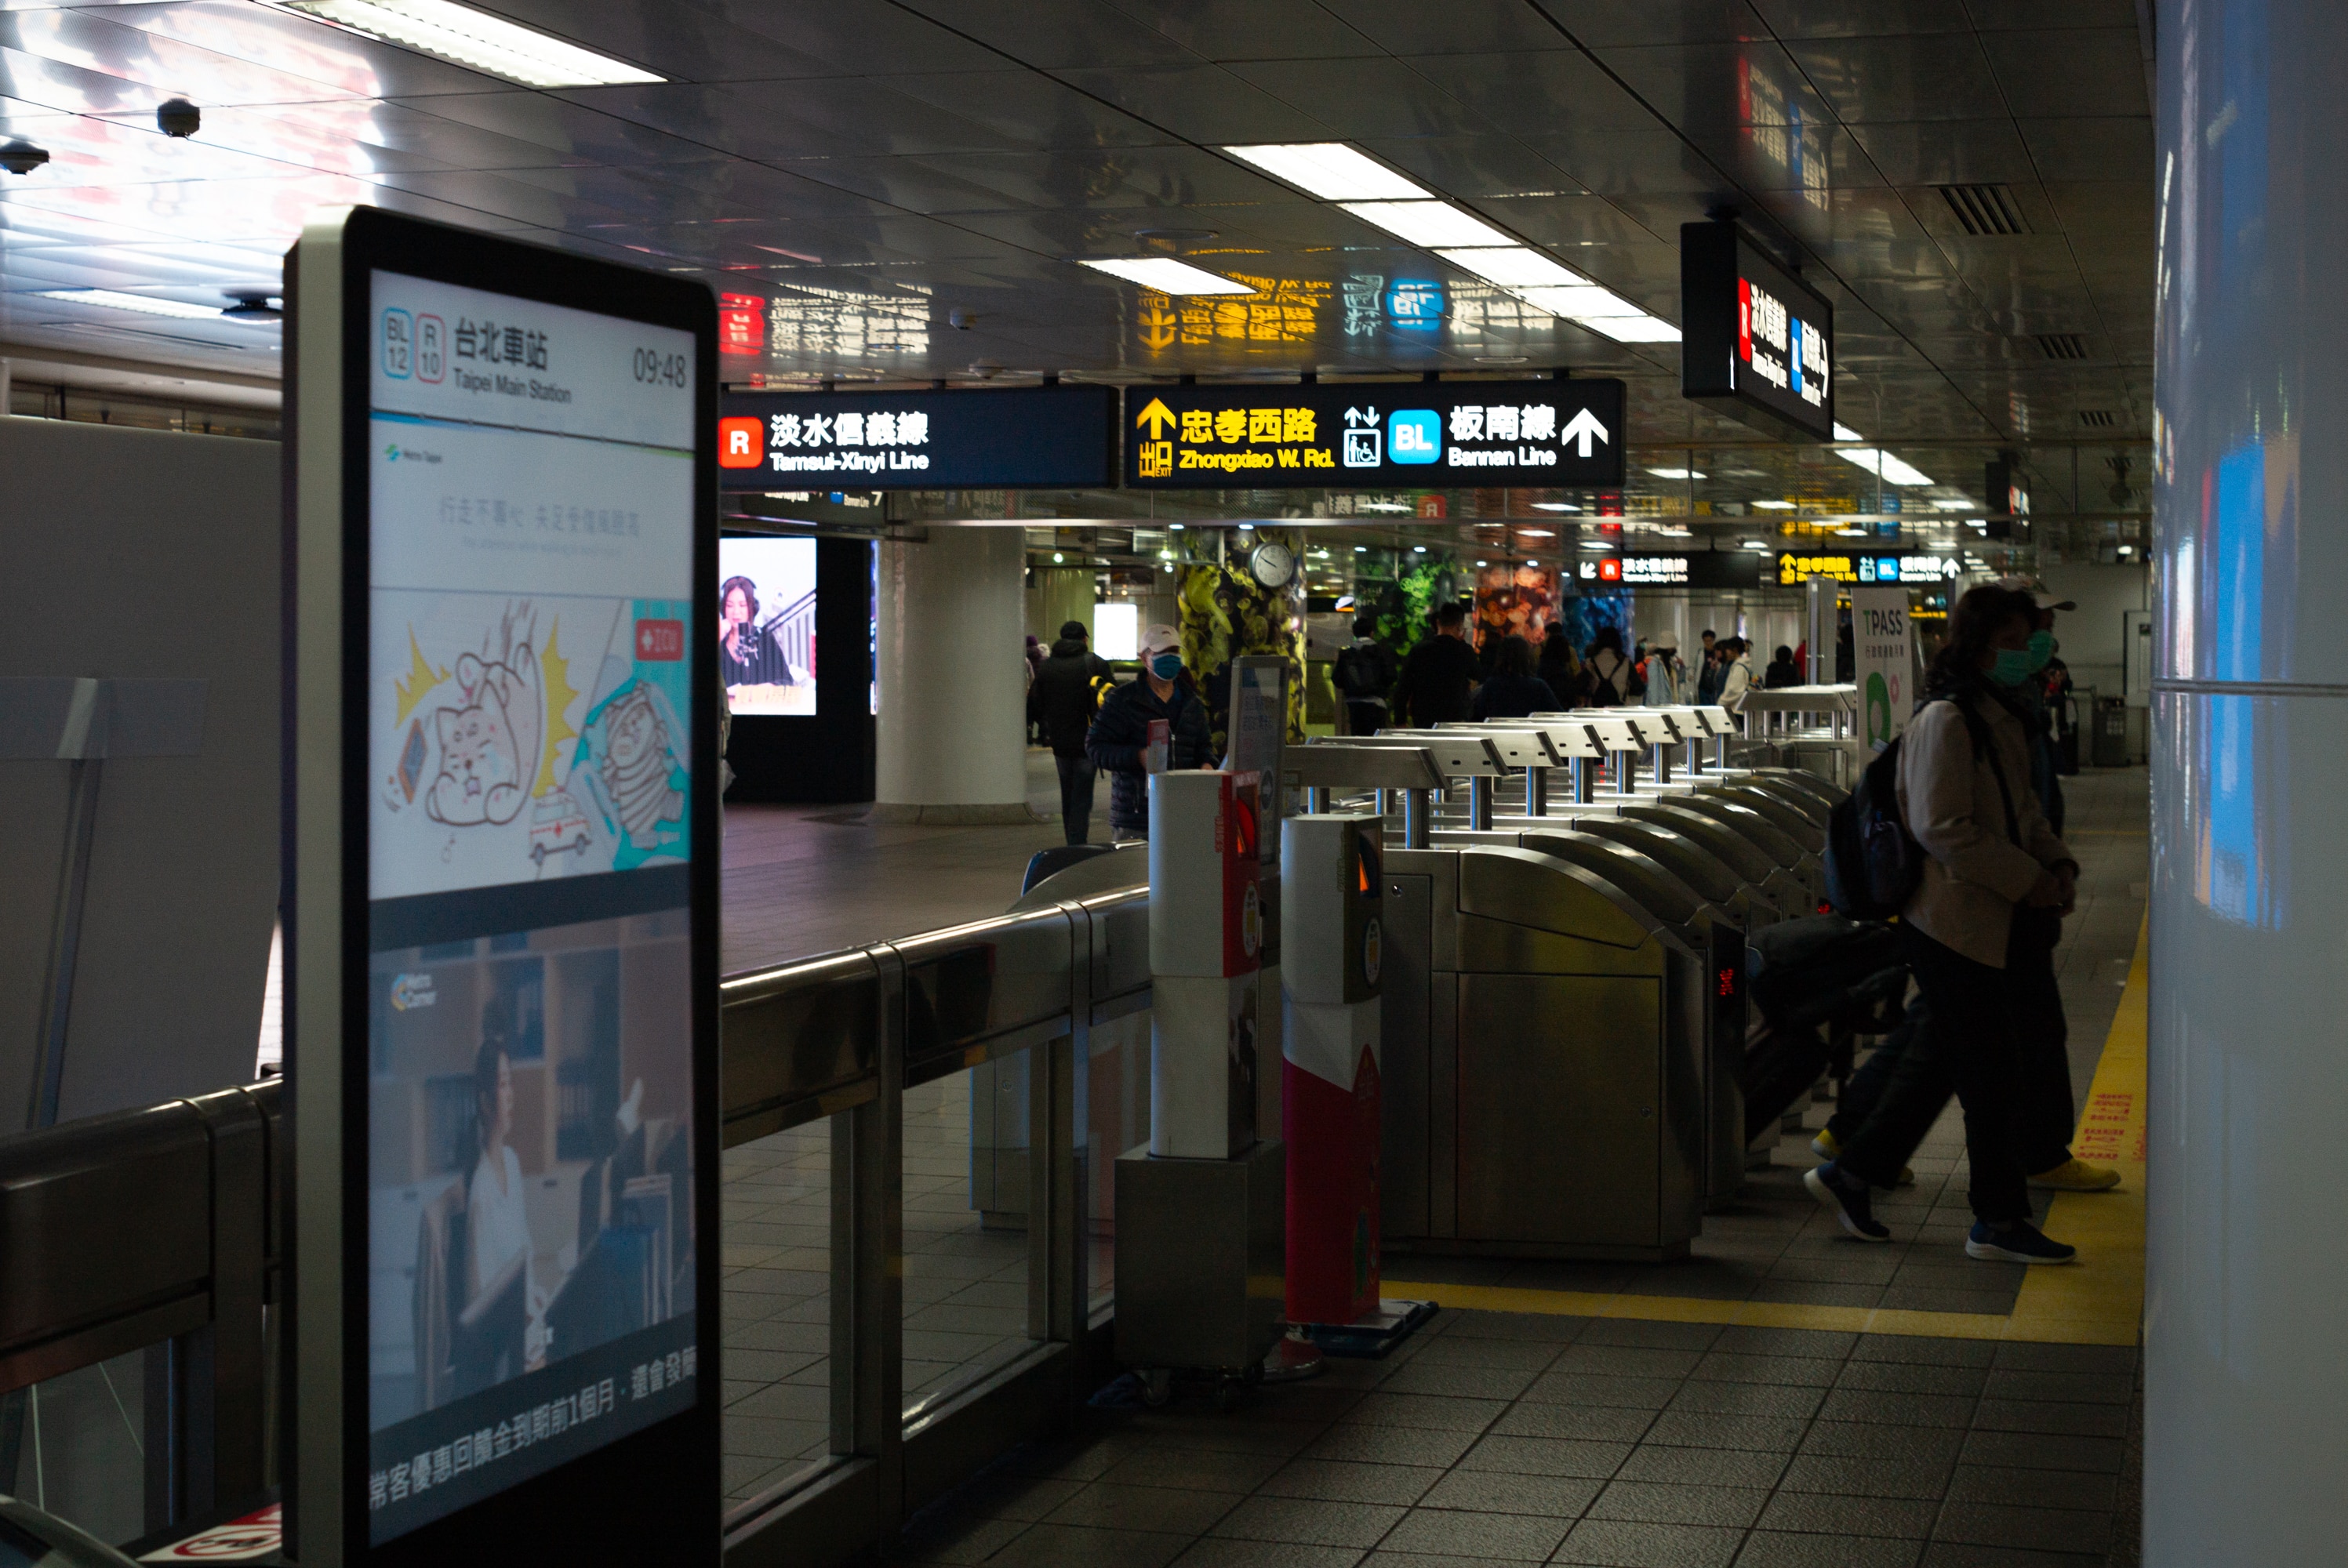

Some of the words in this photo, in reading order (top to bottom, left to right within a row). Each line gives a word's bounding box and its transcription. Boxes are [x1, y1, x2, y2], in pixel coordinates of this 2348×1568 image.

[387, 317, 409, 343] BL
[1741, 301, 1748, 339] R
[424, 324, 437, 347] R
[455, 318, 547, 371] 台北車站
[389, 346, 408, 371] 12
[422, 352, 440, 375] 10
[634, 347, 686, 389] 09:48
[453, 366, 492, 395] Taipei
[496, 374, 526, 396] Main
[529, 379, 572, 403] Station
[770, 410, 929, 448] 淡水信義線
[1179, 407, 1318, 444] 忠孝西路
[1448, 404, 1557, 441] 板南線
[729, 430, 750, 455] R
[1395, 423, 1433, 451] BL
[769, 451, 886, 474] Tamsui-Xinyi
[889, 451, 929, 470] Line
[1139, 441, 1172, 478] 出口
[1179, 449, 1274, 473] Zhongxiao
[1277, 449, 1300, 468] W.
[1304, 449, 1335, 468] Rd.
[1448, 446, 1515, 467] Bannan
[1517, 446, 1557, 466] Line
[1156, 466, 1172, 477] EXIT
[1863, 610, 1903, 636] TPASS
